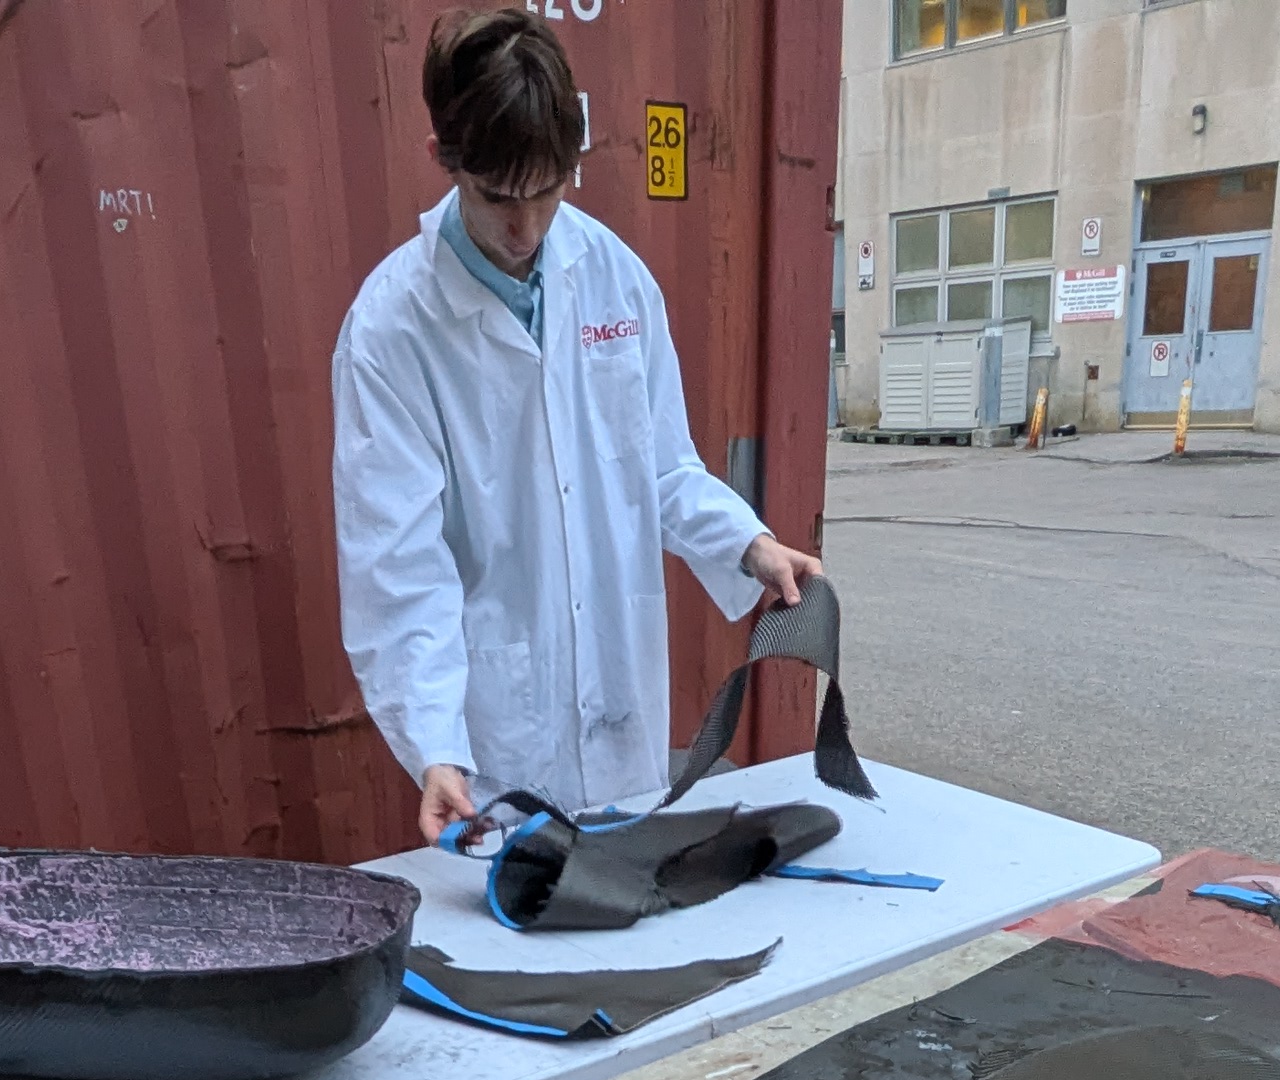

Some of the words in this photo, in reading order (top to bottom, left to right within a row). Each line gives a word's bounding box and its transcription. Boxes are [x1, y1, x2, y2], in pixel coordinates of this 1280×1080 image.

[648, 115, 681, 149] 2.6
[99, 188, 156, 220] MRT!
[592, 318, 640, 343] McGill
